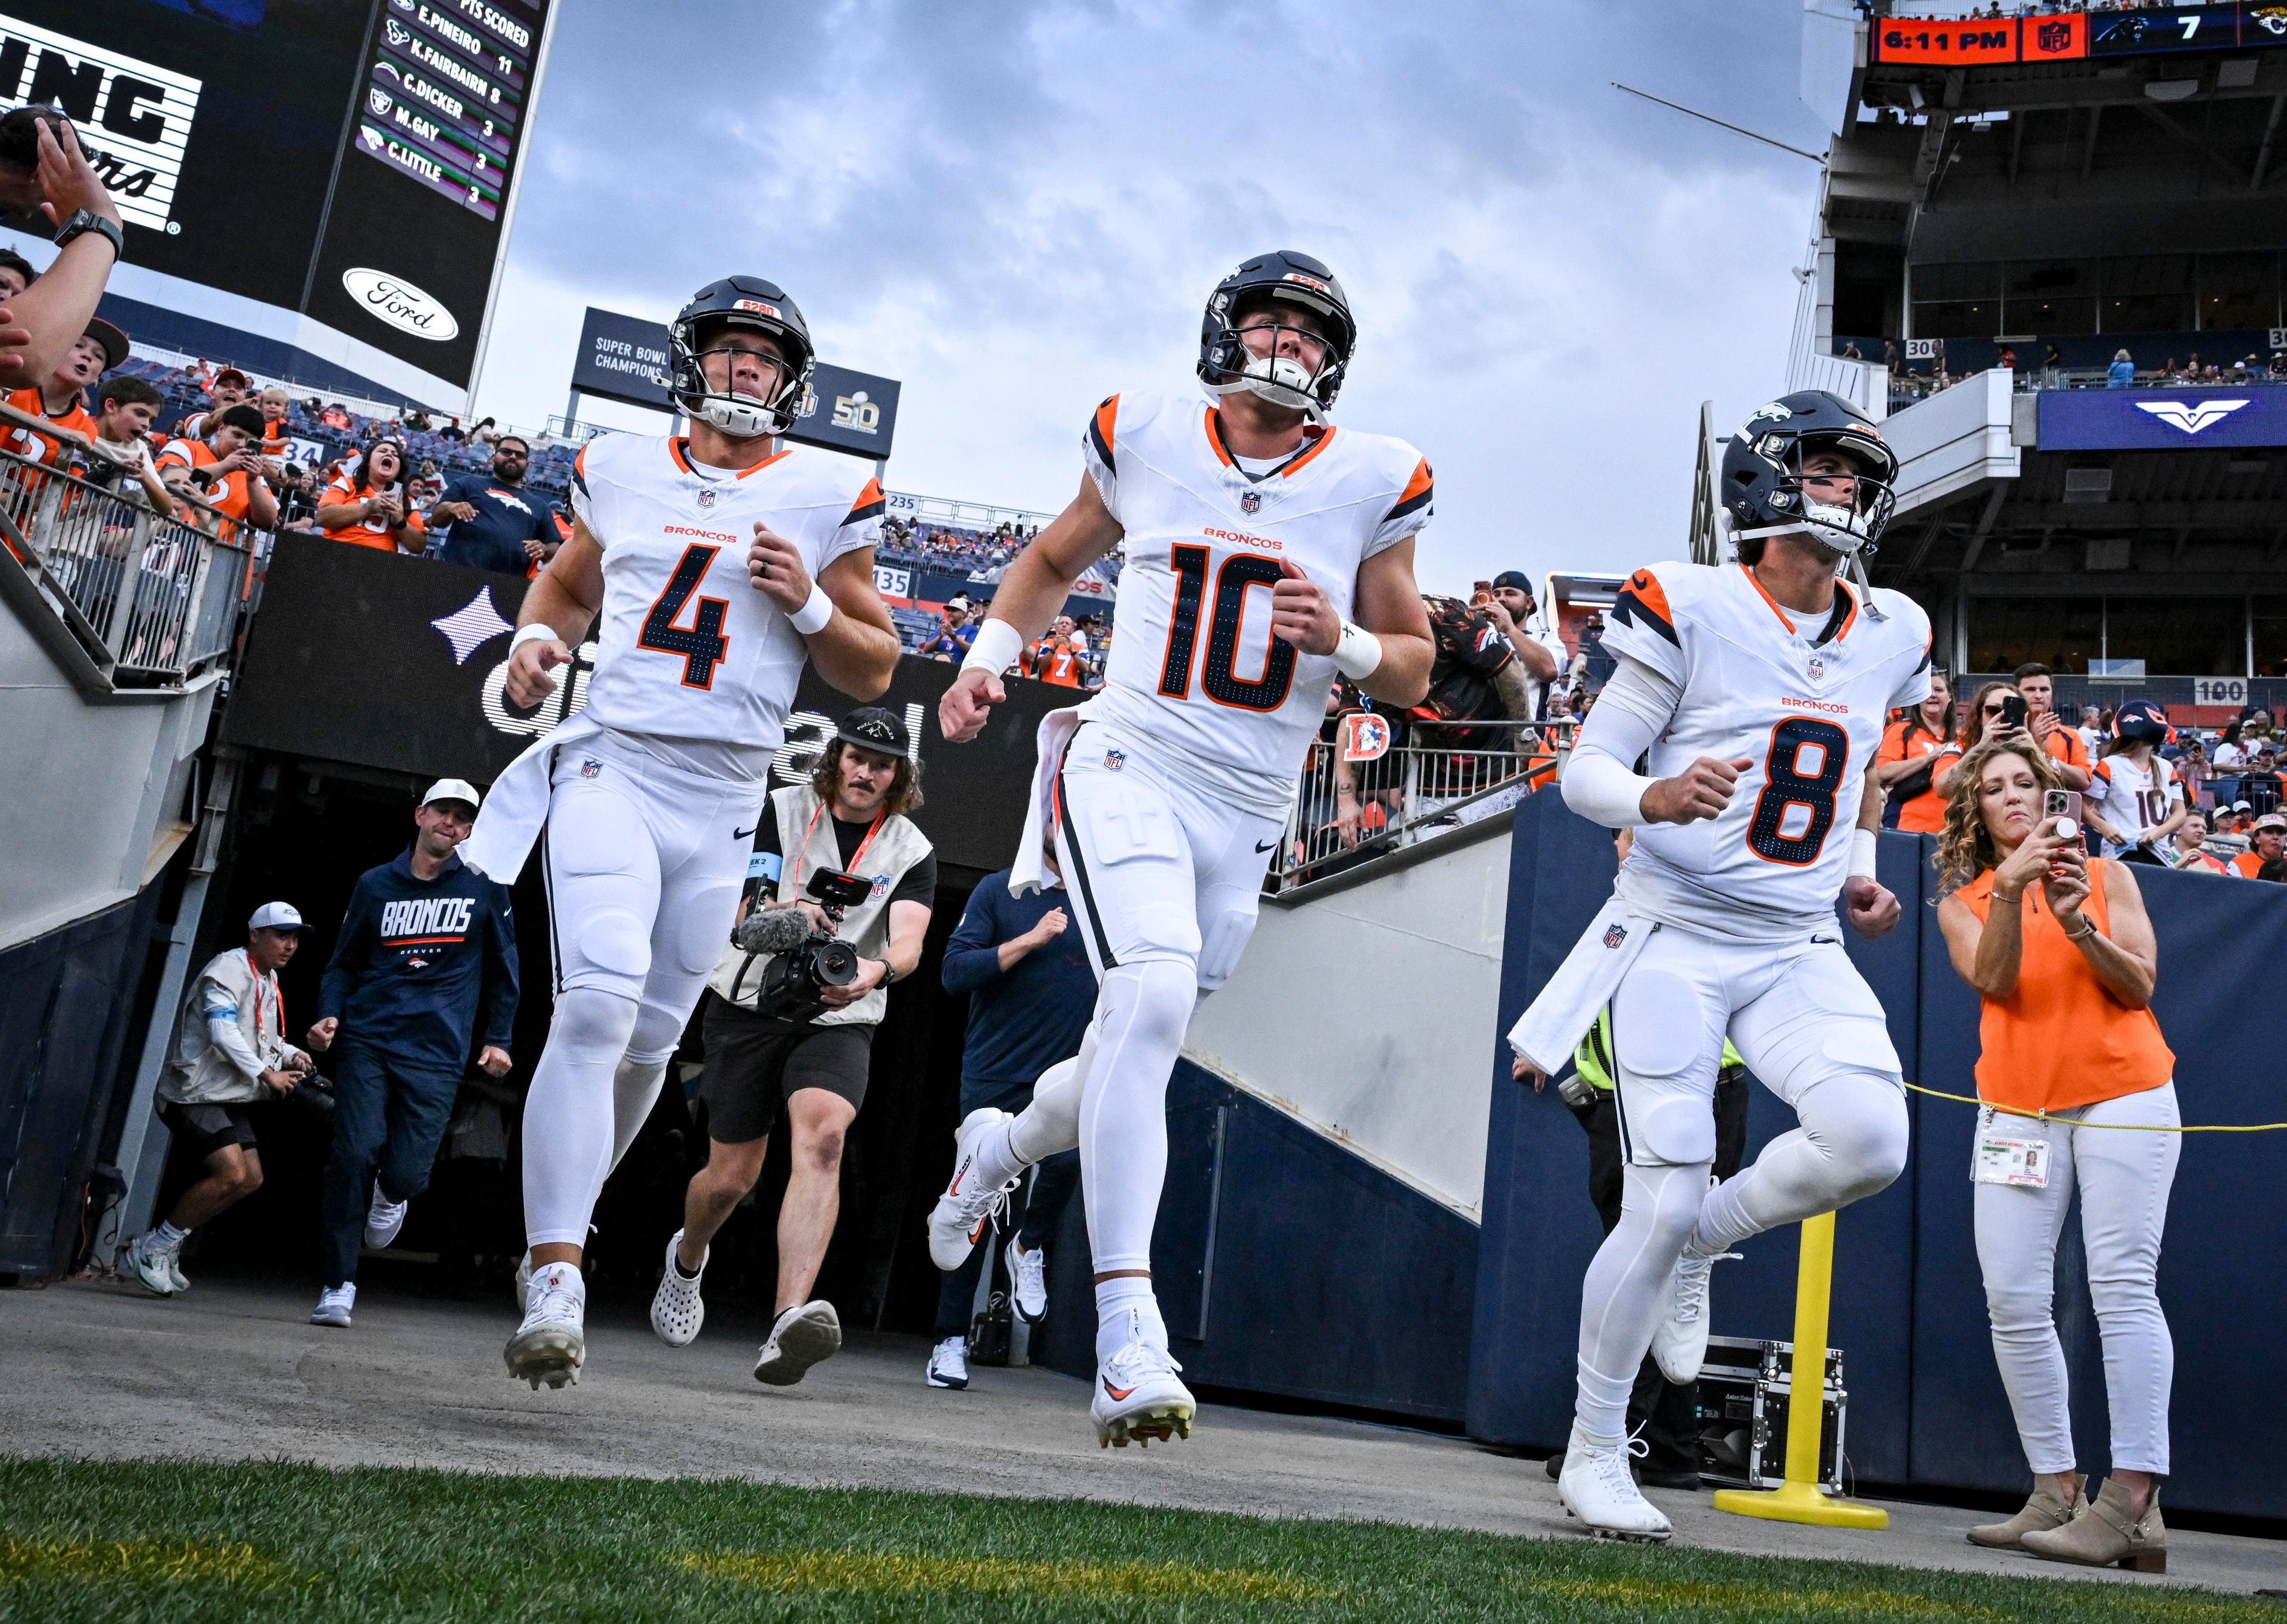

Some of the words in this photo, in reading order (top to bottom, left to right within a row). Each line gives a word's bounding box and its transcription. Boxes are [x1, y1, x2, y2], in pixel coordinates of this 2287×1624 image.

[460, 0, 482, 19] PTS
[483, 8, 529, 48] SCORED
[2177, 15, 2201, 39] 7
[418, 5, 481, 54] E.PINEIRO
[498, 56, 512, 74] 11
[1884, 31, 1948, 51] 6:11
[1959, 30, 2006, 50] PM
[410, 39, 488, 96] K.FAIRBAIRN
[490, 88, 500, 104] 8
[403, 73, 463, 119] C.DICKER
[482, 120, 494, 136] 3
[395, 106, 440, 142] M.GAY
[476, 154, 487, 169] 3
[388, 142, 442, 183] C.LITTLE
[469, 186, 479, 202] 3
[367, 282, 435, 329] Ford
[2272, 331, 2287, 345] 3
[596, 337, 632, 357] SUPER
[636, 347, 667, 366] BOWL
[596, 354, 662, 378] CHAMPIONS
[833, 395, 880, 429] 50
[699, 496, 712, 505] NFL
[890, 495, 915, 509] 235
[1242, 499, 1258, 510] NFL
[664, 525, 737, 543] BRONCOS
[1203, 527, 1283, 551] BRONCOS
[636, 543, 730, 691] 4
[1157, 542, 1308, 713] 10
[1055, 653, 1072, 677] 7
[1810, 666, 1822, 677] NFL
[2199, 681, 2243, 701] 100
[1782, 697, 1849, 714] BRONCOS
[856, 721, 872, 731] PIXEL
[583, 766, 596, 775] NFL
[1105, 756, 1120, 768] NFL
[1746, 715, 1849, 866] 8
[2135, 789, 2167, 828] 10
[849, 850, 864, 874] BRONCO
[871, 884, 886, 894] NFL
[381, 898, 476, 937] BRONCOS
[1605, 932, 1621, 947] NFL
